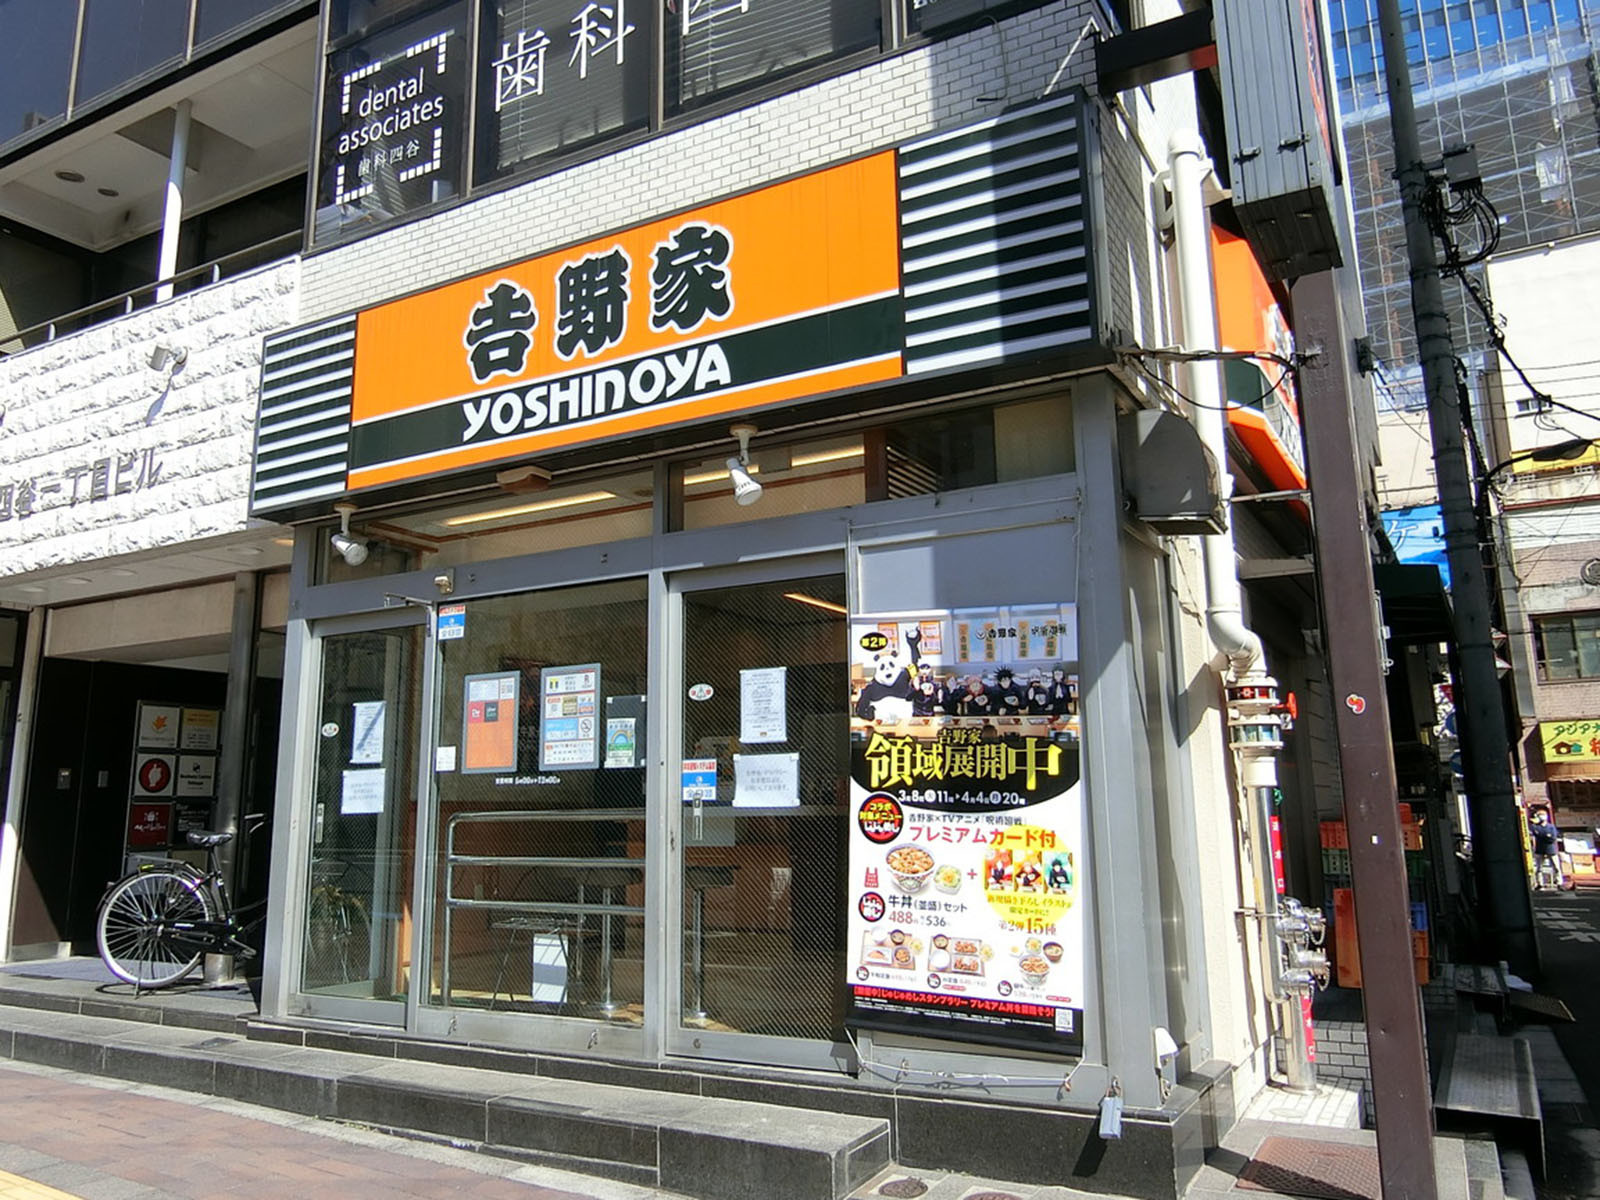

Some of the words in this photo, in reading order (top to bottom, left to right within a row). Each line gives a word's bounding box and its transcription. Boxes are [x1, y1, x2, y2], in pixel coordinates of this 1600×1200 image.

[359, 67, 424, 117] dental
[338, 96, 444, 154] associates
[358, 140, 420, 177] 歯科四谷
[465, 221, 734, 385] 吉野家
[463, 343, 732, 442] YOSHINOYA
[865, 733, 1063, 791] 領域展開中
[909, 826, 1056, 849] プレミアムカード付
